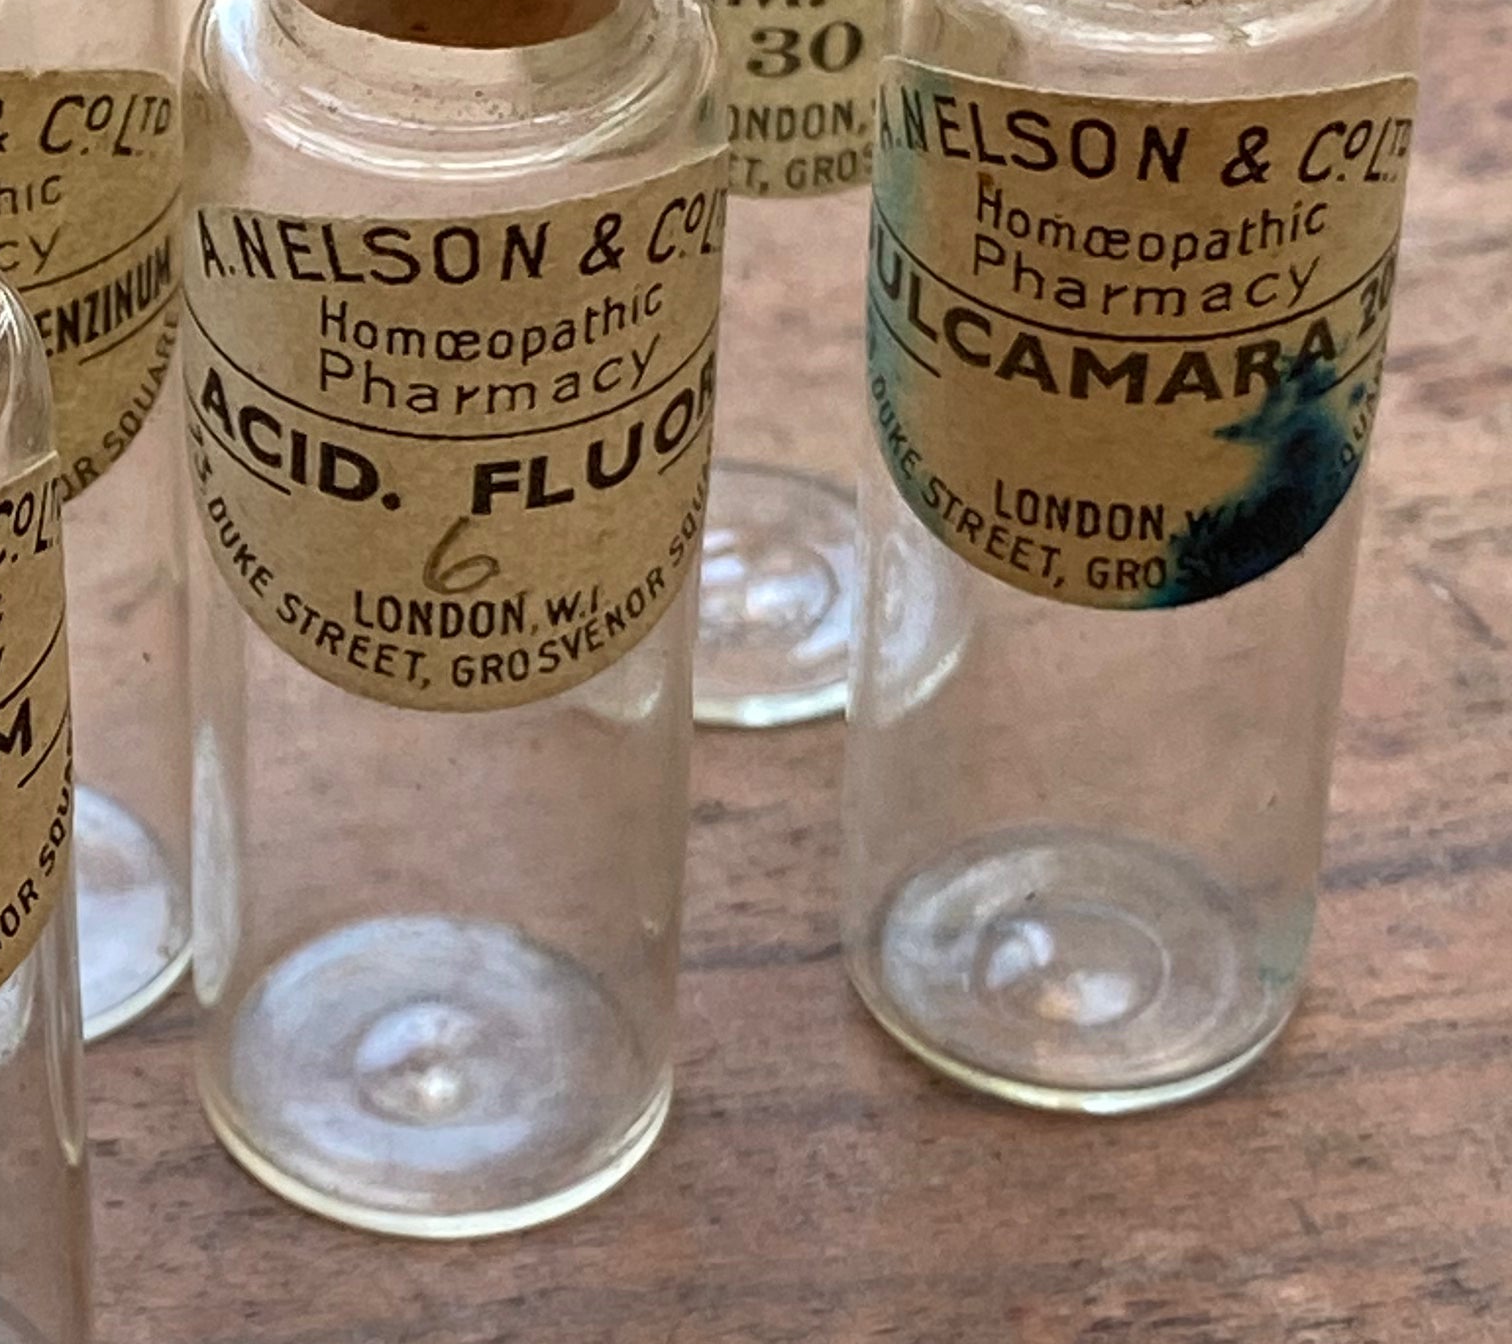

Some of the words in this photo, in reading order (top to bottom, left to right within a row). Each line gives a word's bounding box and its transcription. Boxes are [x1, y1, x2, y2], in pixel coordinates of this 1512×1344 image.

[746, 20, 864, 79] 30
[1221, 126, 1272, 188] &
[577, 213, 625, 277] &
[973, 233, 1321, 319] Pharmacy
[34, 234, 171, 358] ENZINUM
[871, 226, 1337, 405] ULCAMARA
[319, 333, 661, 416] Pharmacy
[202, 367, 402, 513] ACID.
[871, 376, 922, 480] DUKE
[207, 496, 275, 599] DUKE
[452, 567, 668, 688] GROSVENOR
[422, 515, 502, 596] 6
